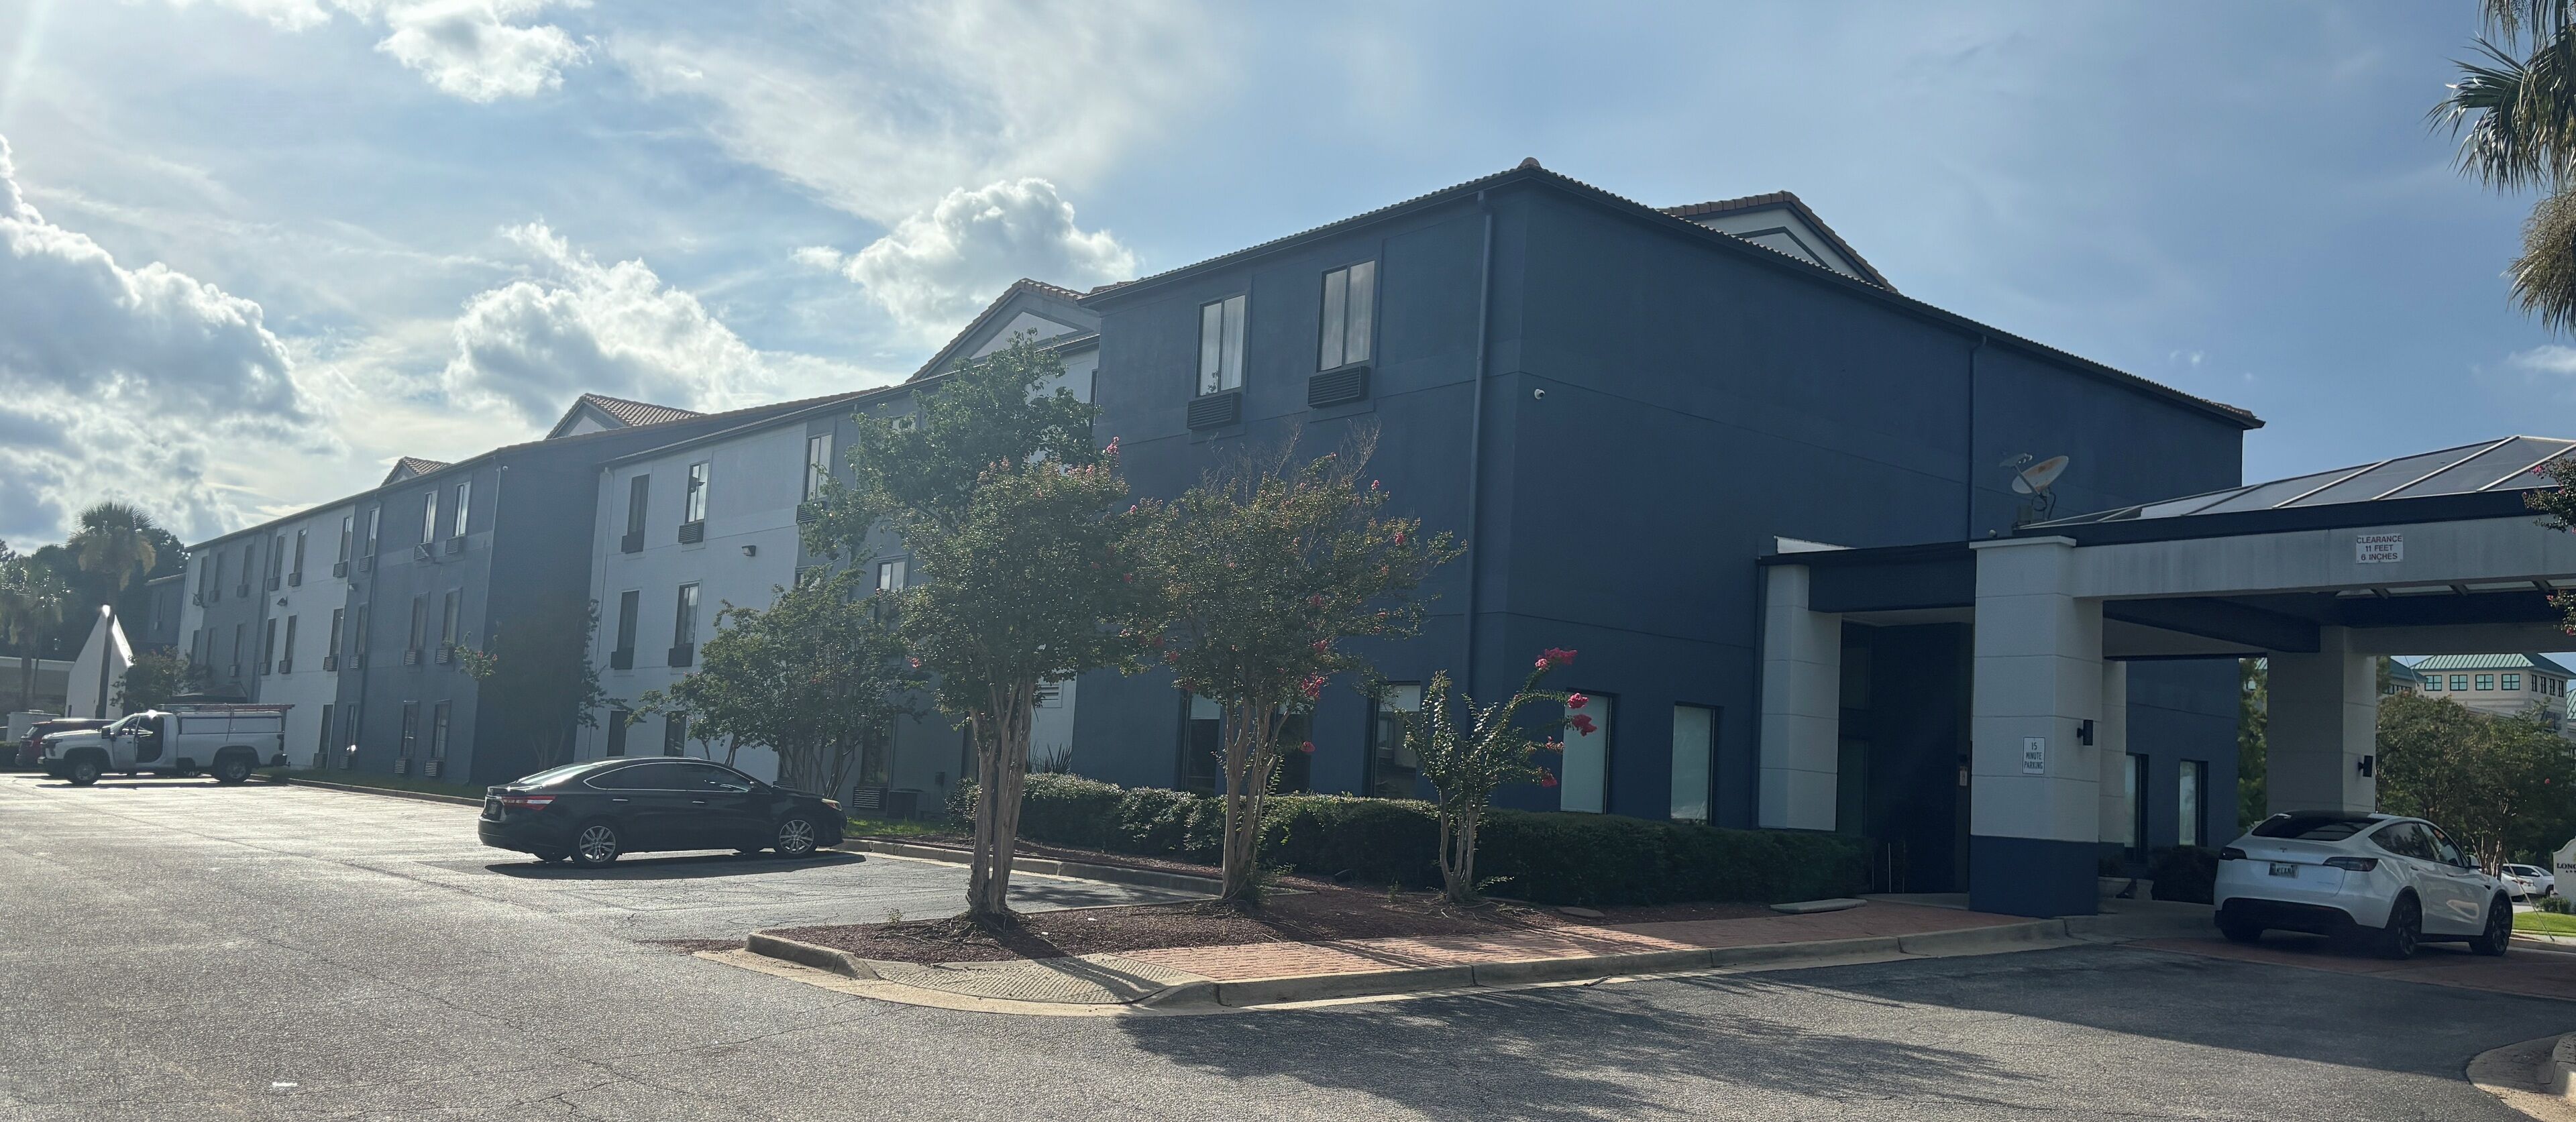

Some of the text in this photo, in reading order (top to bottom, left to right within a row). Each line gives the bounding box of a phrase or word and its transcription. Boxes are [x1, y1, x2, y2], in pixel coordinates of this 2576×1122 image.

[2357, 536, 2402, 544] CLEARANCE
[2369, 553, 2398, 561] INCHES
[2031, 742, 2037, 750] 15
[2026, 752, 2042, 760] MINUTE
[2024, 761, 2043, 769] PARKING
